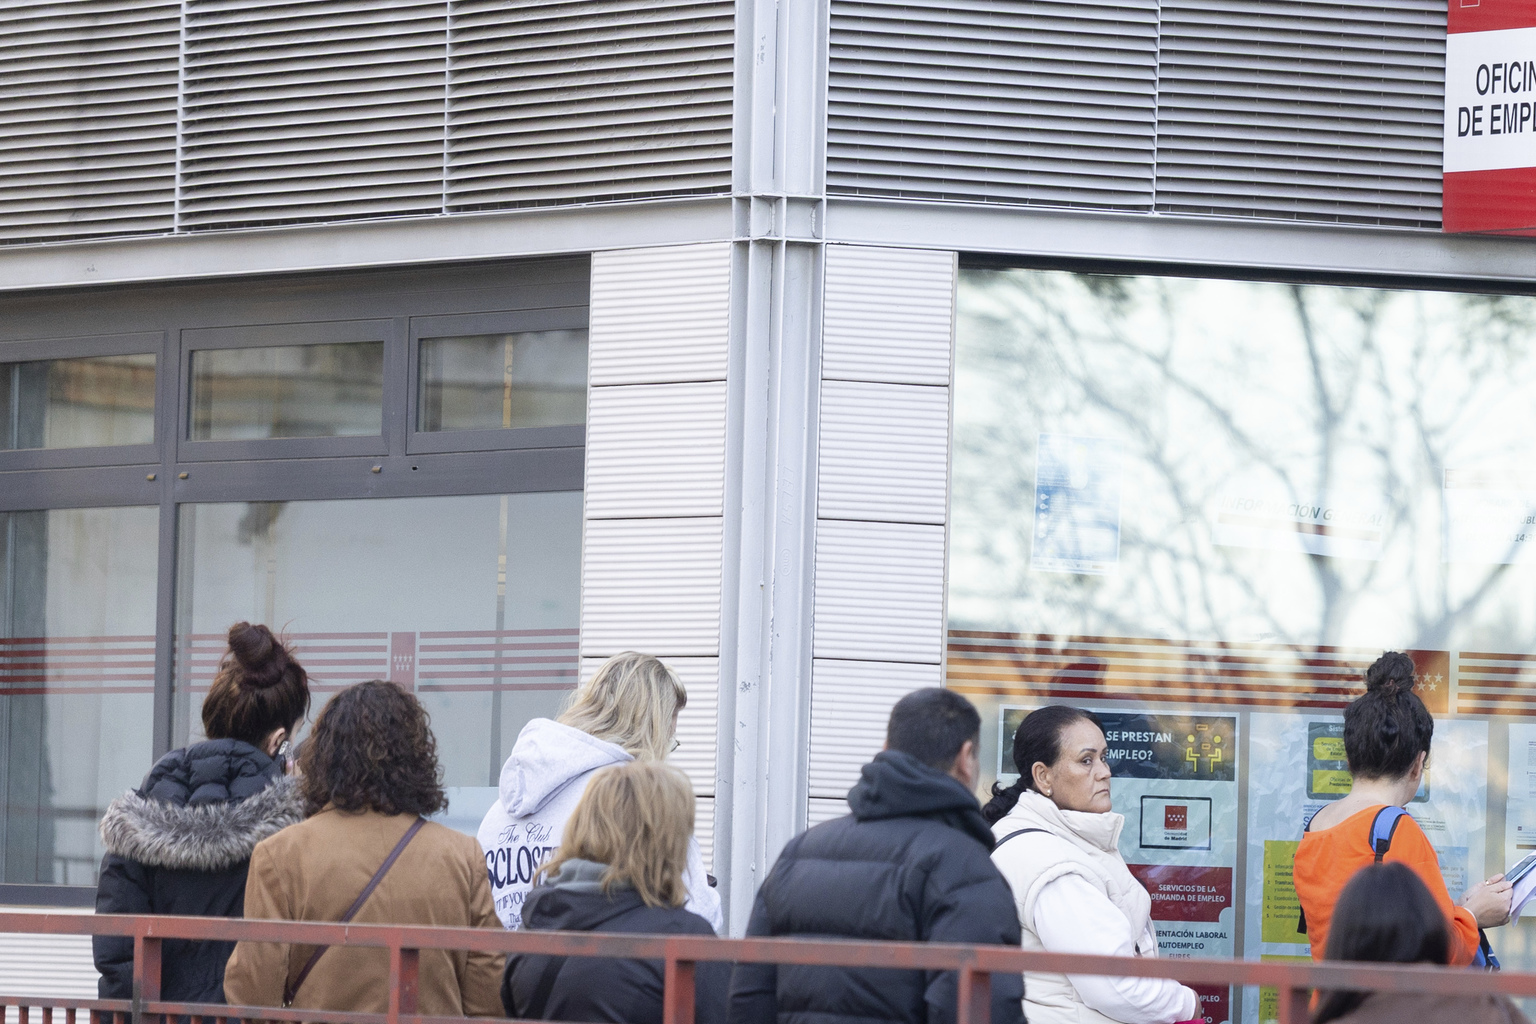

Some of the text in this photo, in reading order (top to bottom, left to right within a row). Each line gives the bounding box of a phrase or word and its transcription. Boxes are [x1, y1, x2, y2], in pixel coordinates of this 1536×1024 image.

[1458, 105, 1484, 137] DE
[1221, 495, 1383, 527] INFORMACIÓN GENERAL
[1106, 731, 1172, 743] SE PRESTAN
[1105, 748, 1153, 761] EMPLEO?
[497, 821, 553, 845] The Club
[1158, 884, 1196, 893] SERVICIOS
[1197, 885, 1206, 893] DE
[1151, 893, 1226, 903] DEMANDA DE EMPLEO
[1195, 931, 1228, 939] LABORAL
[1158, 941, 1205, 950] AUTOEMPLEO
